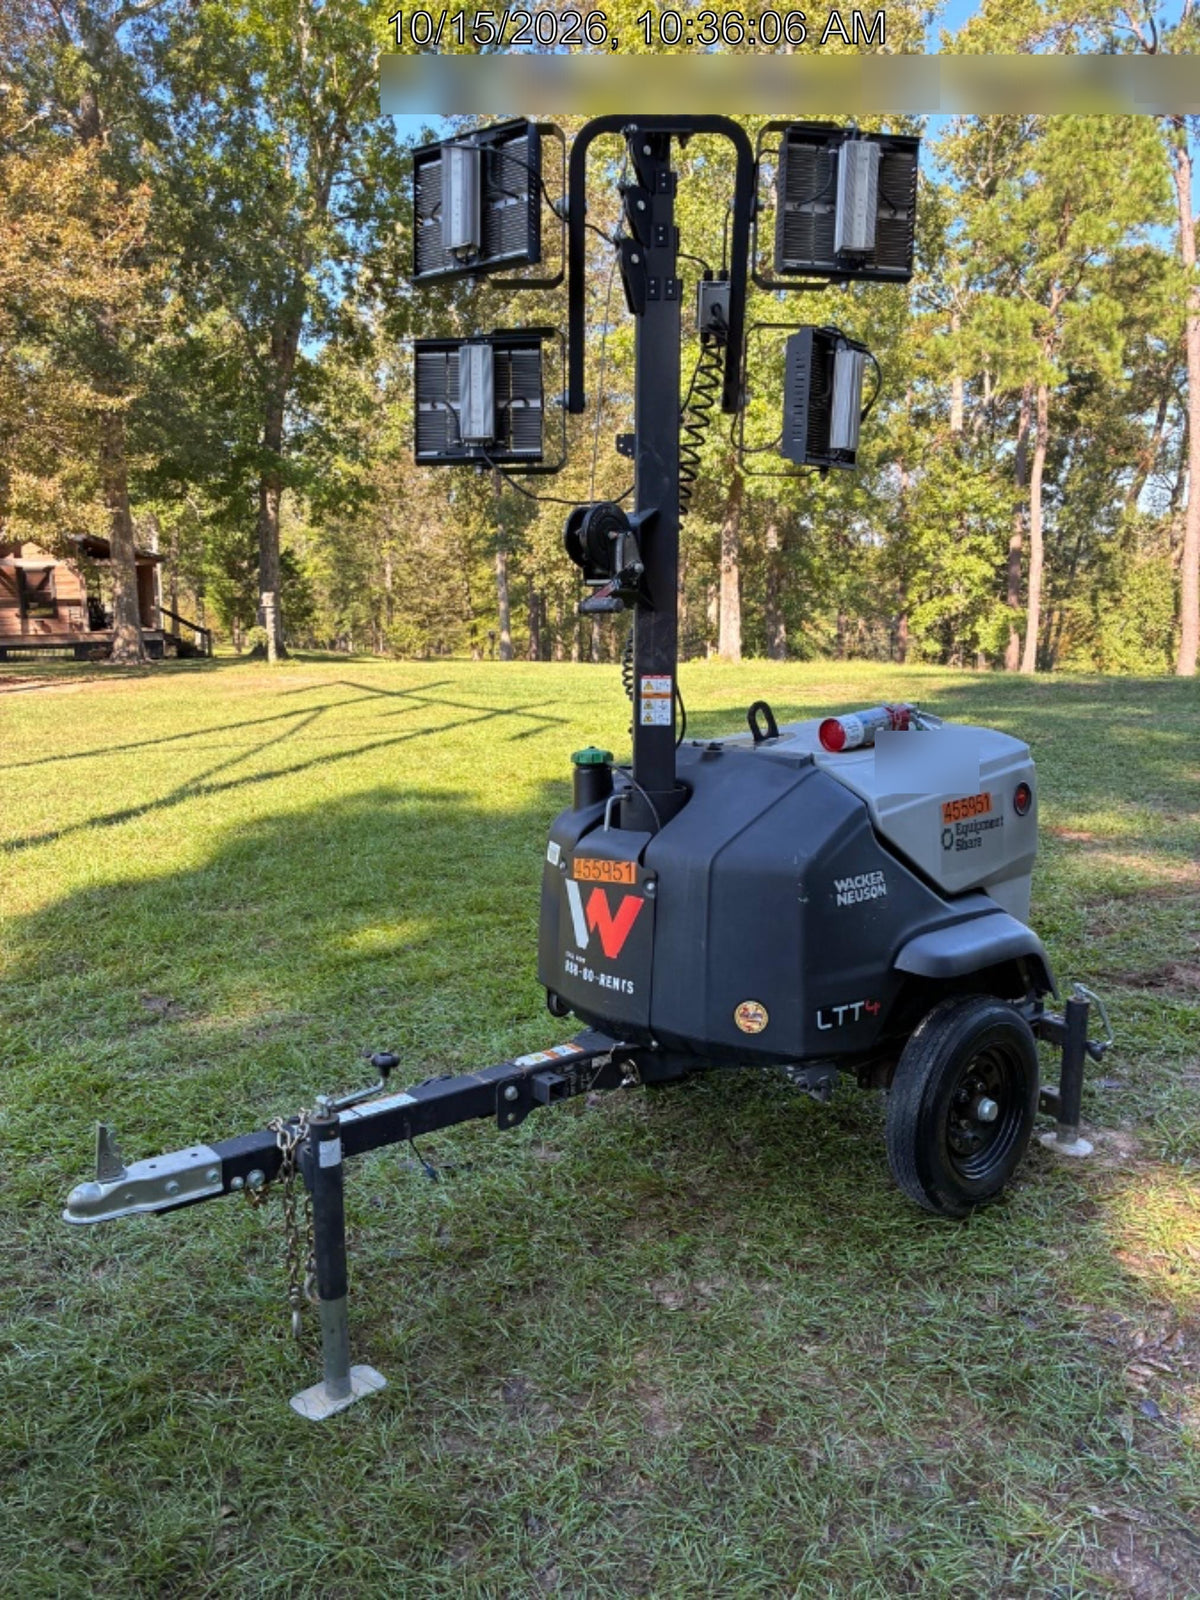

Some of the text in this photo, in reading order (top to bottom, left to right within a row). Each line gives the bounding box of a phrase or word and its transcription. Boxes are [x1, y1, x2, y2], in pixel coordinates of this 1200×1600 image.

[944, 794, 990, 823] 455951
[955, 814, 1004, 837] Equipment
[955, 837, 982, 852] Share
[574, 860, 633, 882] 455951
[833, 870, 885, 893] WACKER
[836, 883, 887, 907] NEUSON
[817, 999, 882, 1030] LTT4
